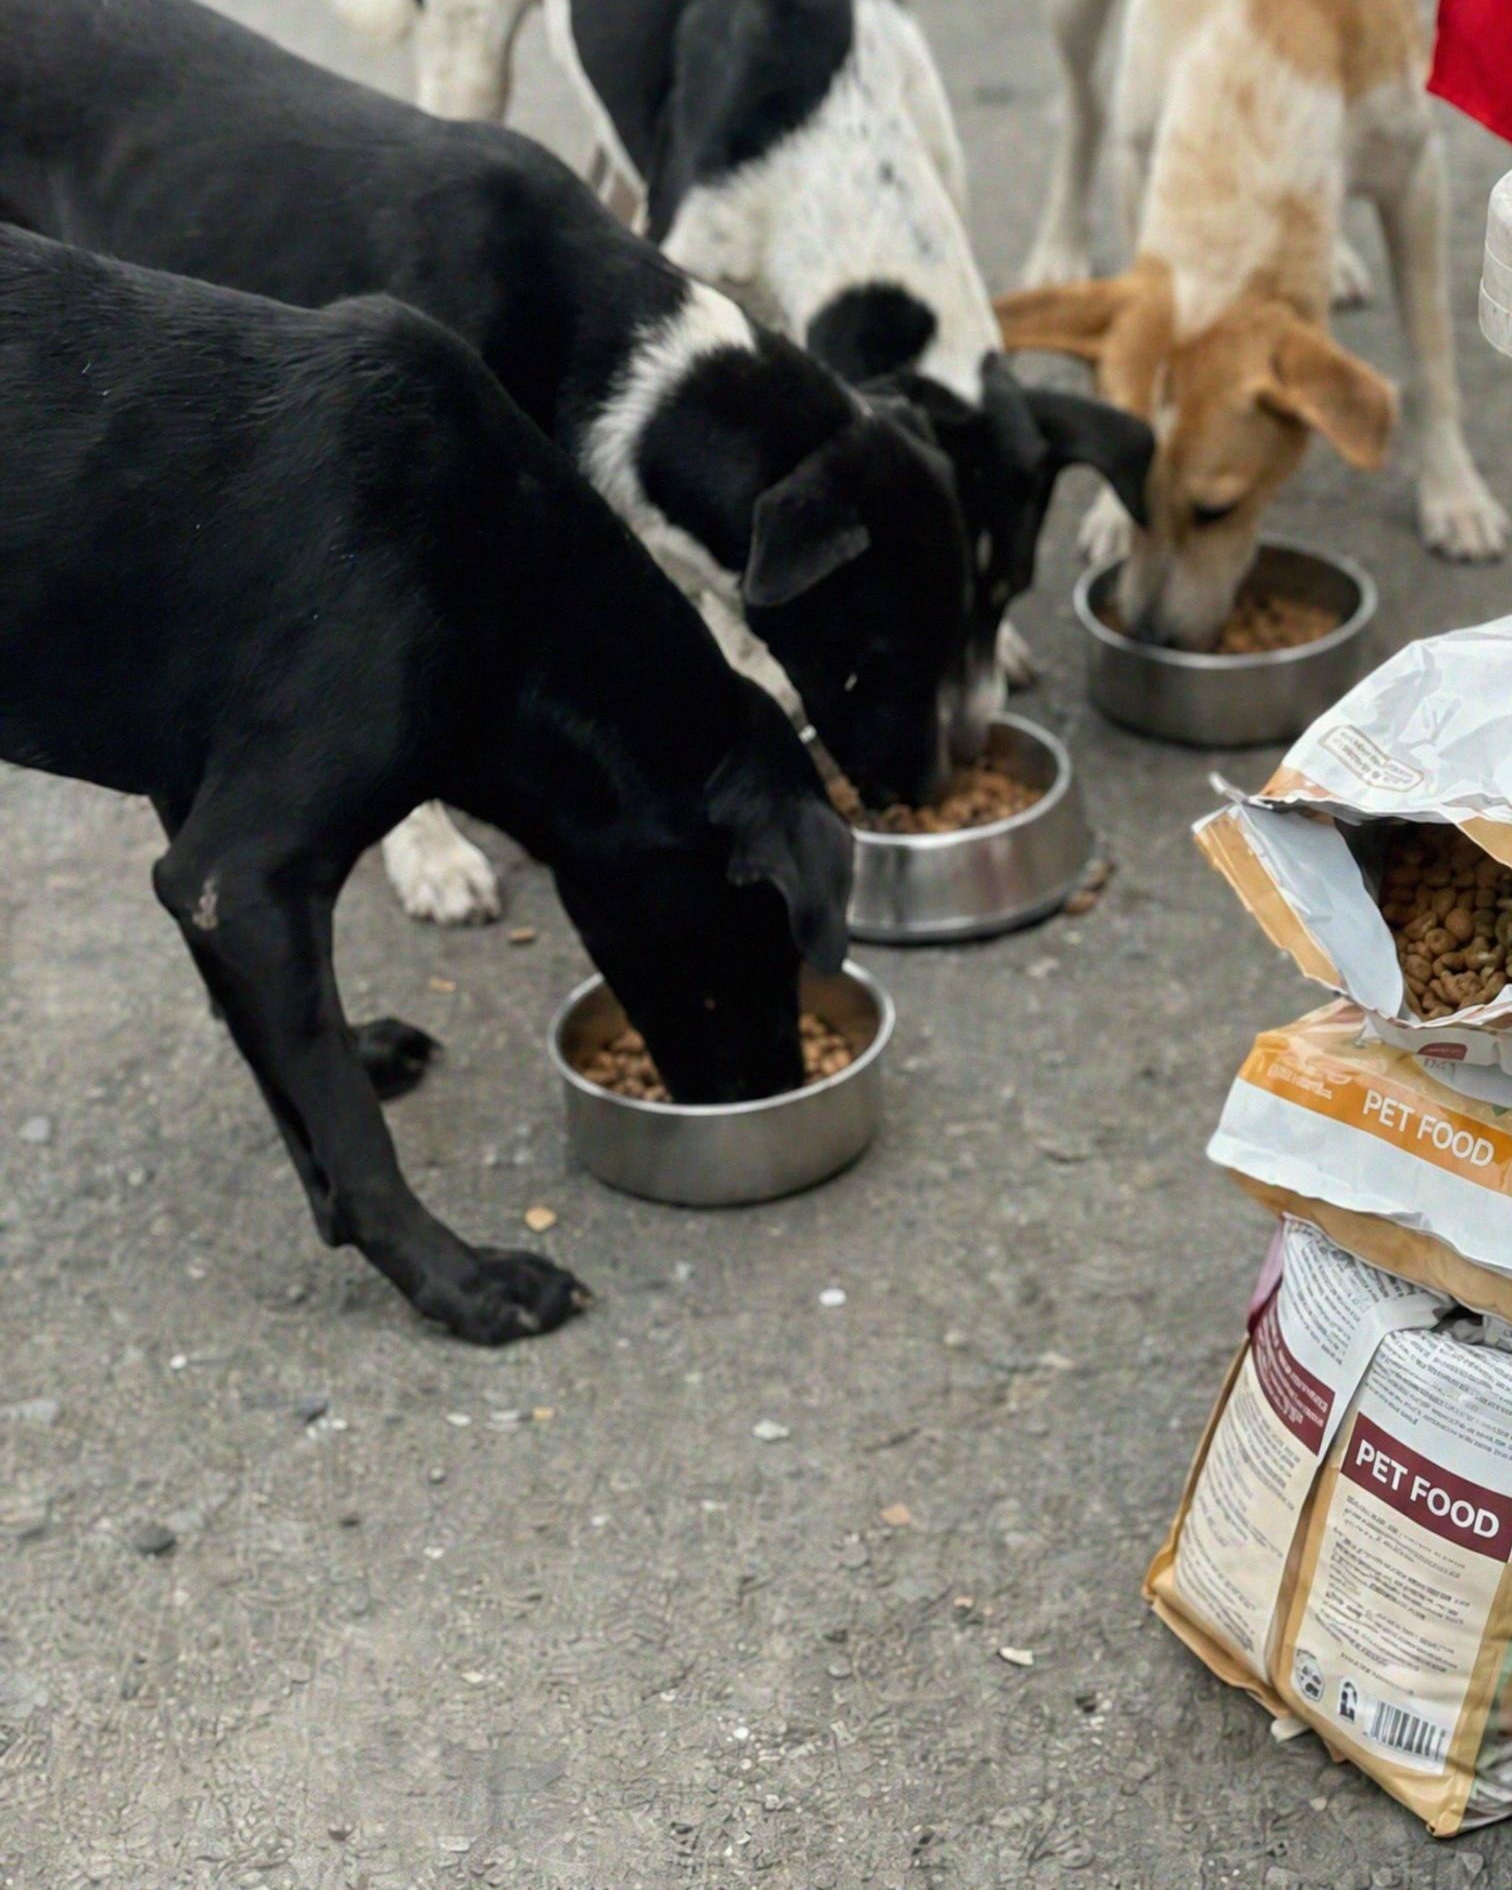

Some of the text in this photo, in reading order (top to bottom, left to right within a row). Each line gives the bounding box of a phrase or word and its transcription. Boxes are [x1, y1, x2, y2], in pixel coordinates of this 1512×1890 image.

[1361, 1089, 1496, 1168] PET FOOD
[1355, 1438, 1409, 1491] PET
[1408, 1476, 1500, 1540] FOOD
